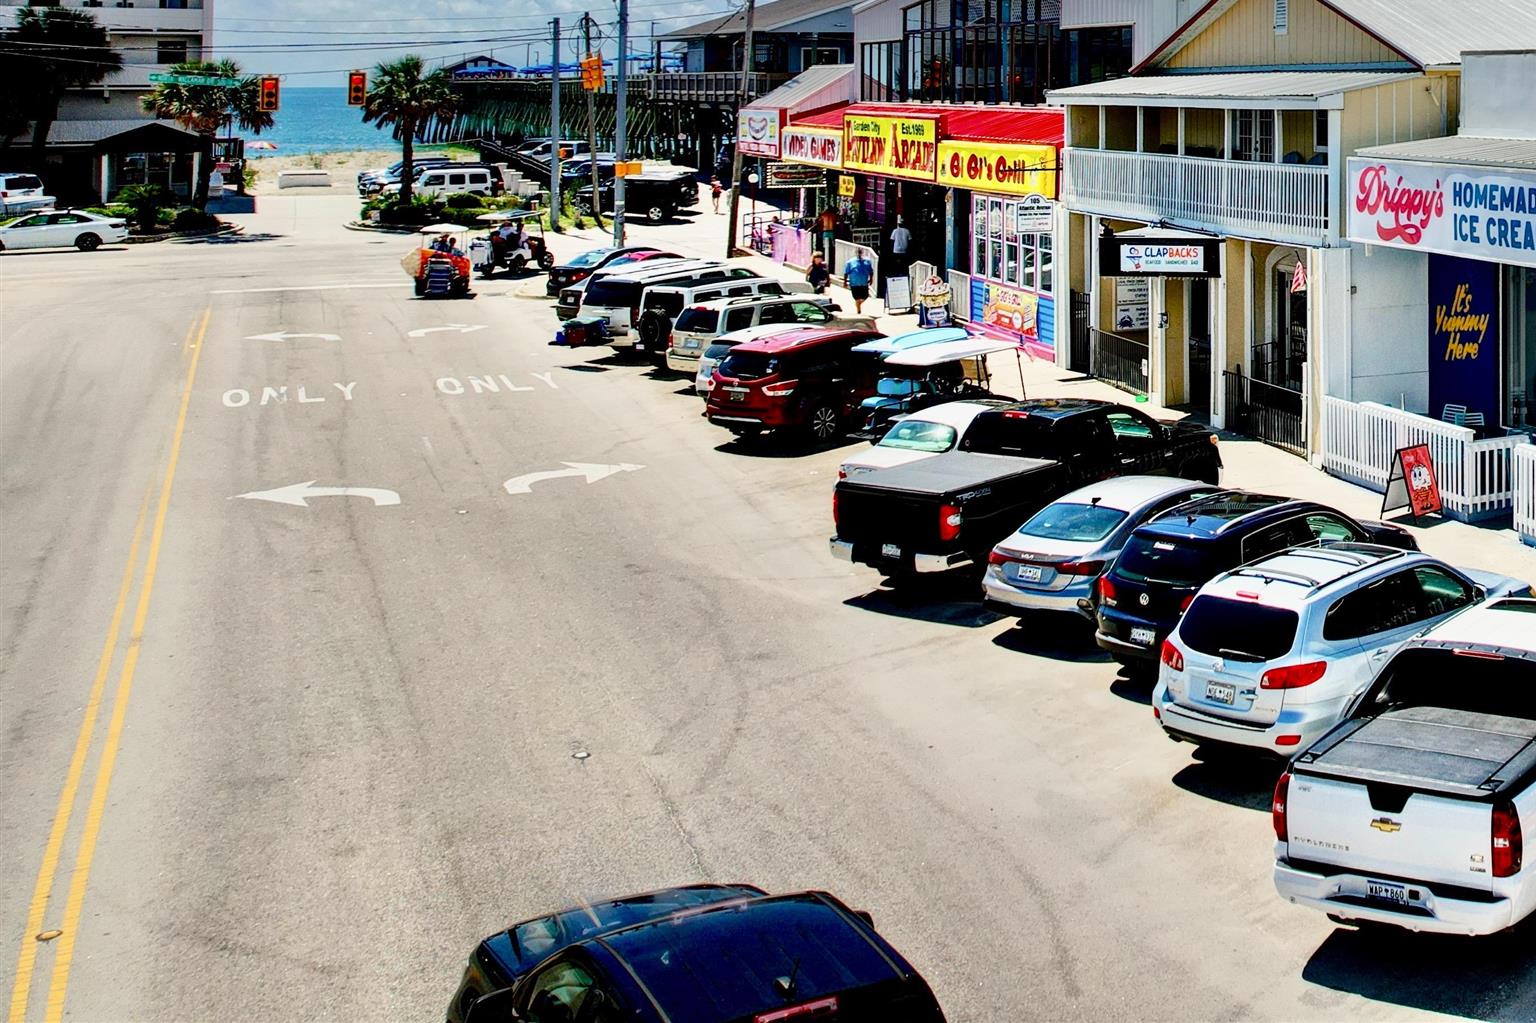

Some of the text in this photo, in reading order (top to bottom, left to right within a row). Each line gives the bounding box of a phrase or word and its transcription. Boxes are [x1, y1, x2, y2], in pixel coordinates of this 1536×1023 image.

[789, 134, 808, 157] VIDEO
[811, 137, 835, 161] GAMES
[1356, 165, 1444, 245] Drippy's
[1453, 214, 1480, 243] ICE
[1144, 247, 1198, 258] CLAPBACKS
[1451, 283, 1472, 316] It's
[1434, 305, 1489, 344] Yummy
[1445, 332, 1479, 361] Here
[222, 382, 357, 407] ONLY
[435, 372, 561, 395] ONLY
[1390, 888, 1404, 900] 860
